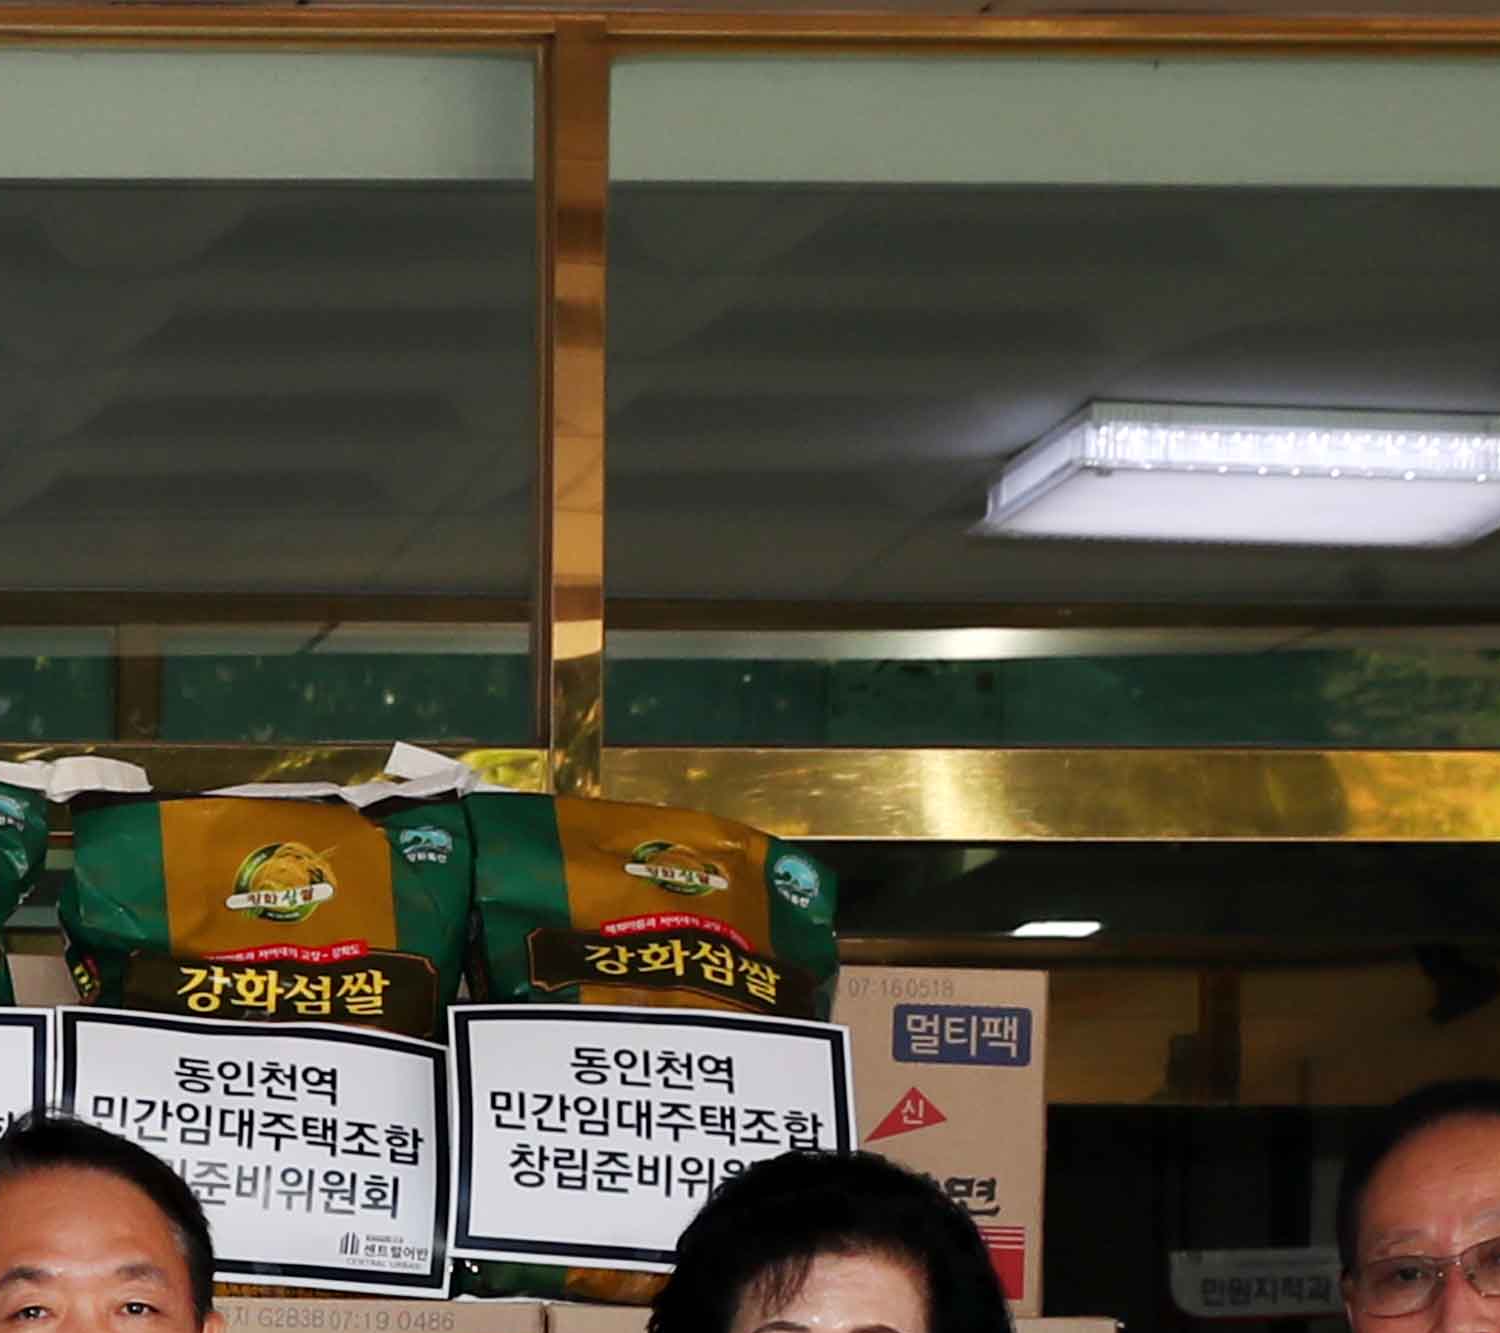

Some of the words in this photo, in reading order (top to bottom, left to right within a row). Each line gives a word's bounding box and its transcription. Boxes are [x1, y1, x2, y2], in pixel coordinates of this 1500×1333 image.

[176, 965, 391, 1016] 강화섬쌀
[585, 938, 781, 1005] 강화섬쌀
[905, 1012, 1019, 1058] 멀티팩
[173, 1058, 339, 1105] 동인천역
[569, 1046, 736, 1094] 동인천역
[91, 1094, 425, 1166] 민간임대주택조합
[489, 1090, 824, 1152] 민간임대주택조합
[900, 1098, 926, 1126] 신
[170, 1156, 401, 1219] 준비위원회
